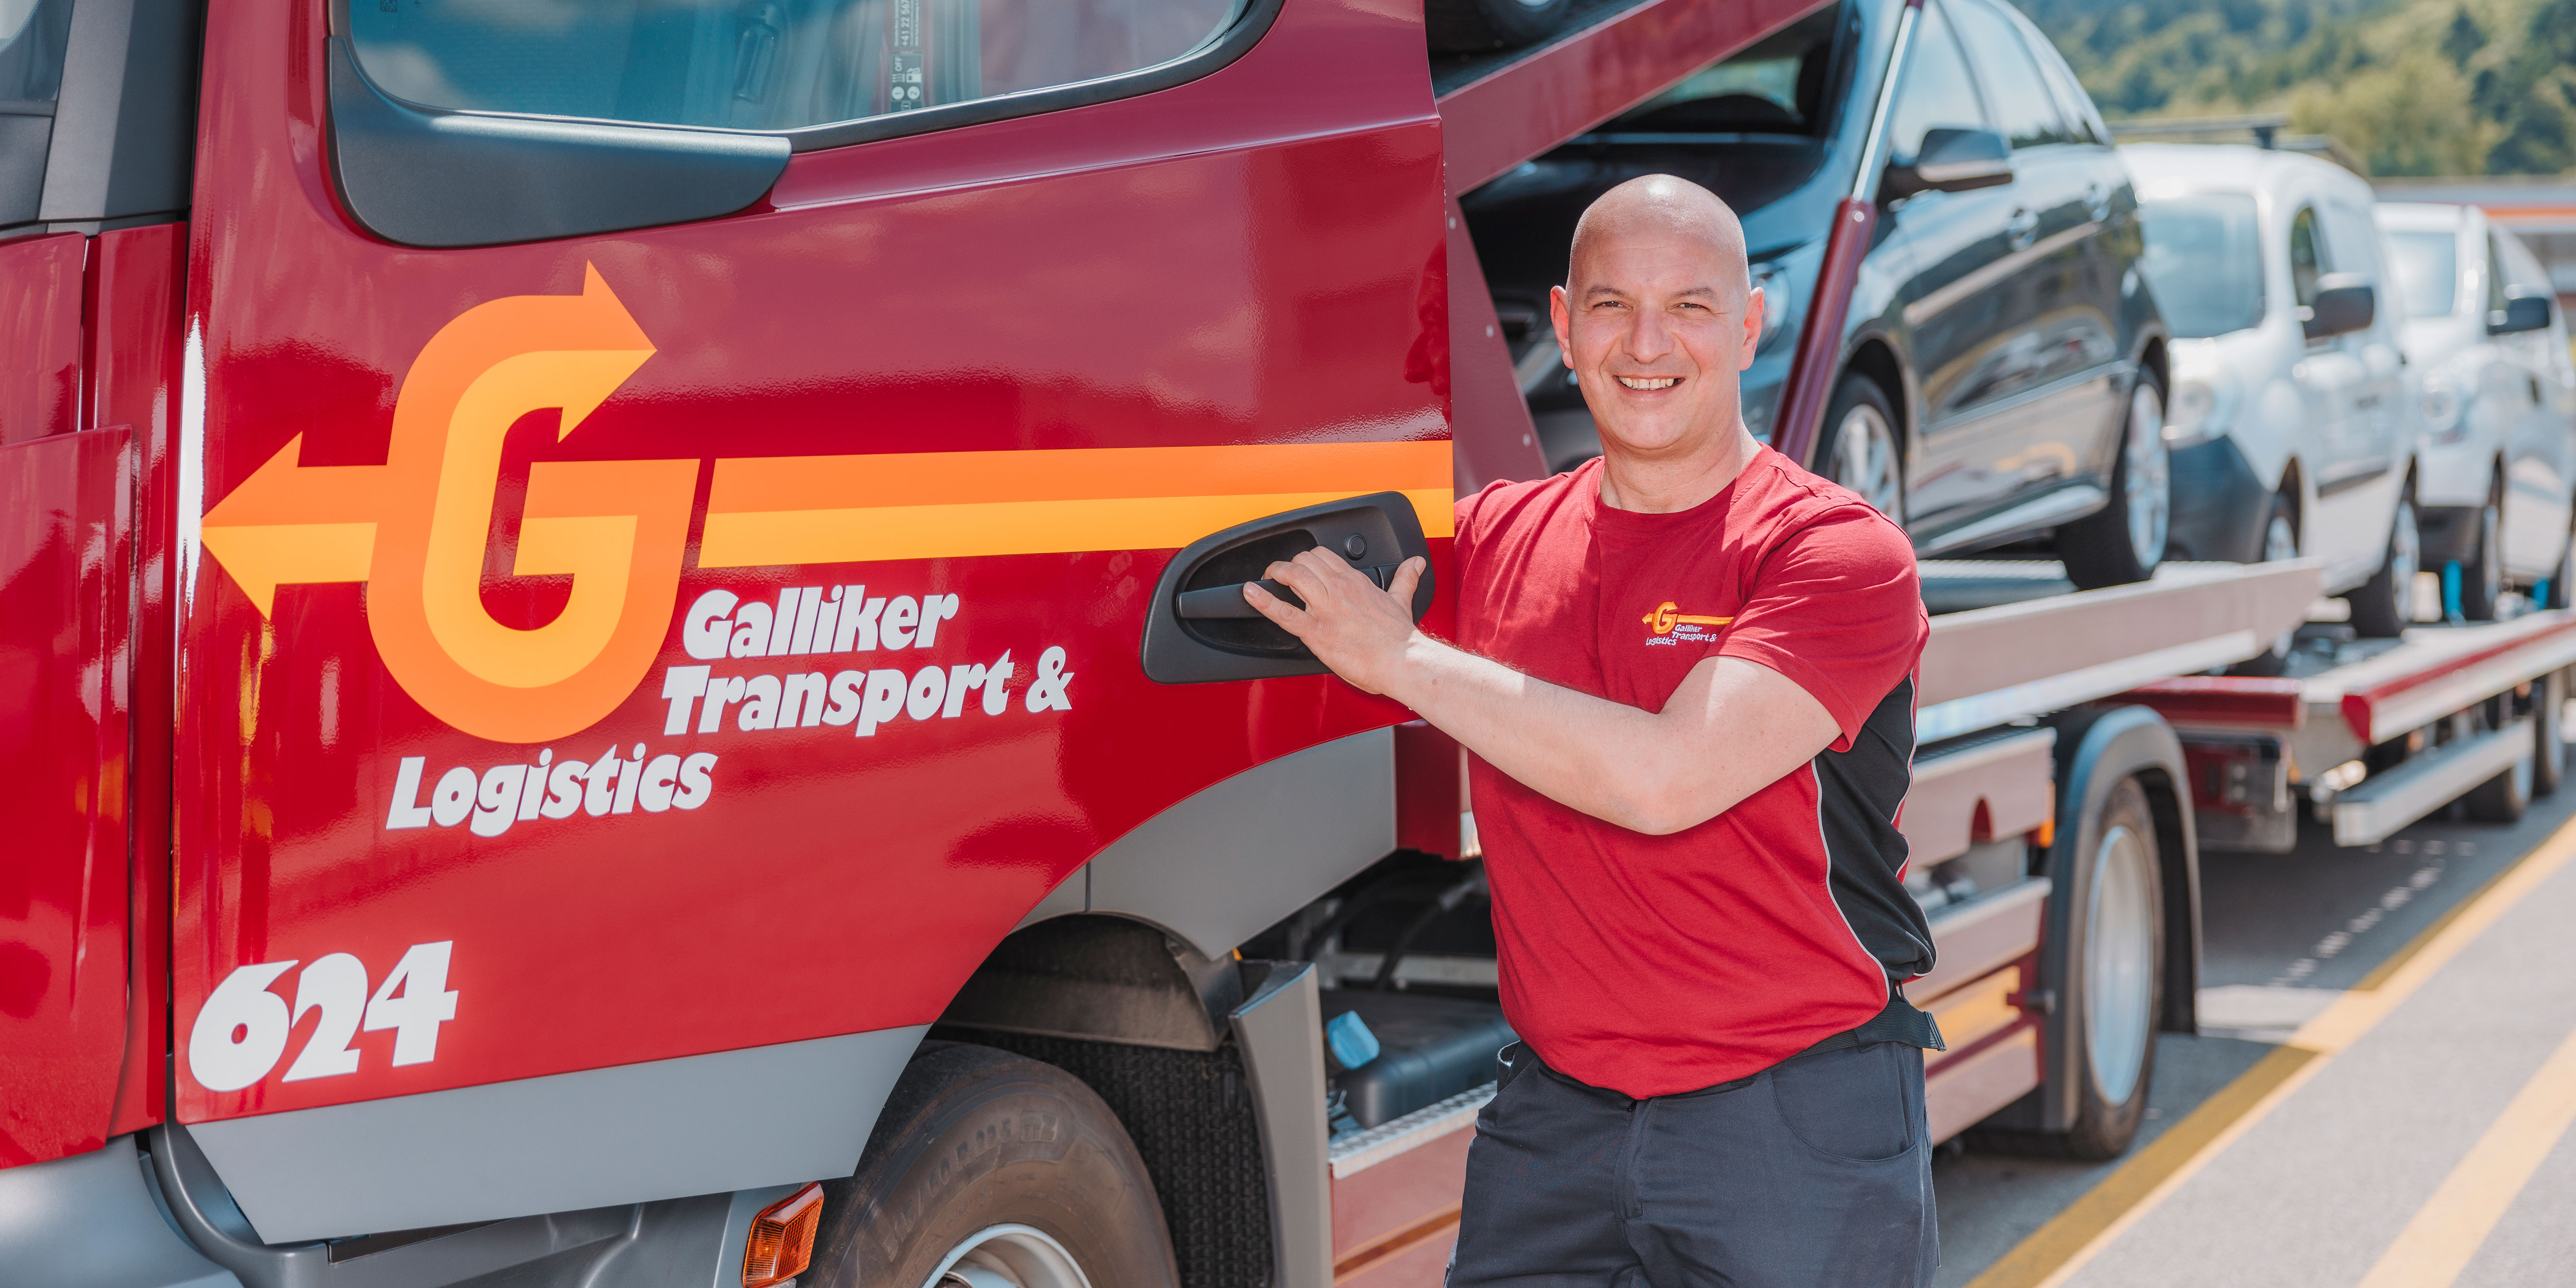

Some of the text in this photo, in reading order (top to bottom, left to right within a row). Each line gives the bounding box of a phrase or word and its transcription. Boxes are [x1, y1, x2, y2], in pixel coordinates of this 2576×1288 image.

[900, 16, 910, 28] 22
[894, 56, 903, 72] OFF
[683, 585, 959, 659] Galliker
[1674, 624, 1702, 633] Galliker
[1645, 636, 1677, 646] Logistics
[1671, 631, 1717, 642] Transport &
[662, 646, 1075, 737] Transport &
[385, 742, 719, 837] Logistics
[189, 940, 459, 1092] 624
